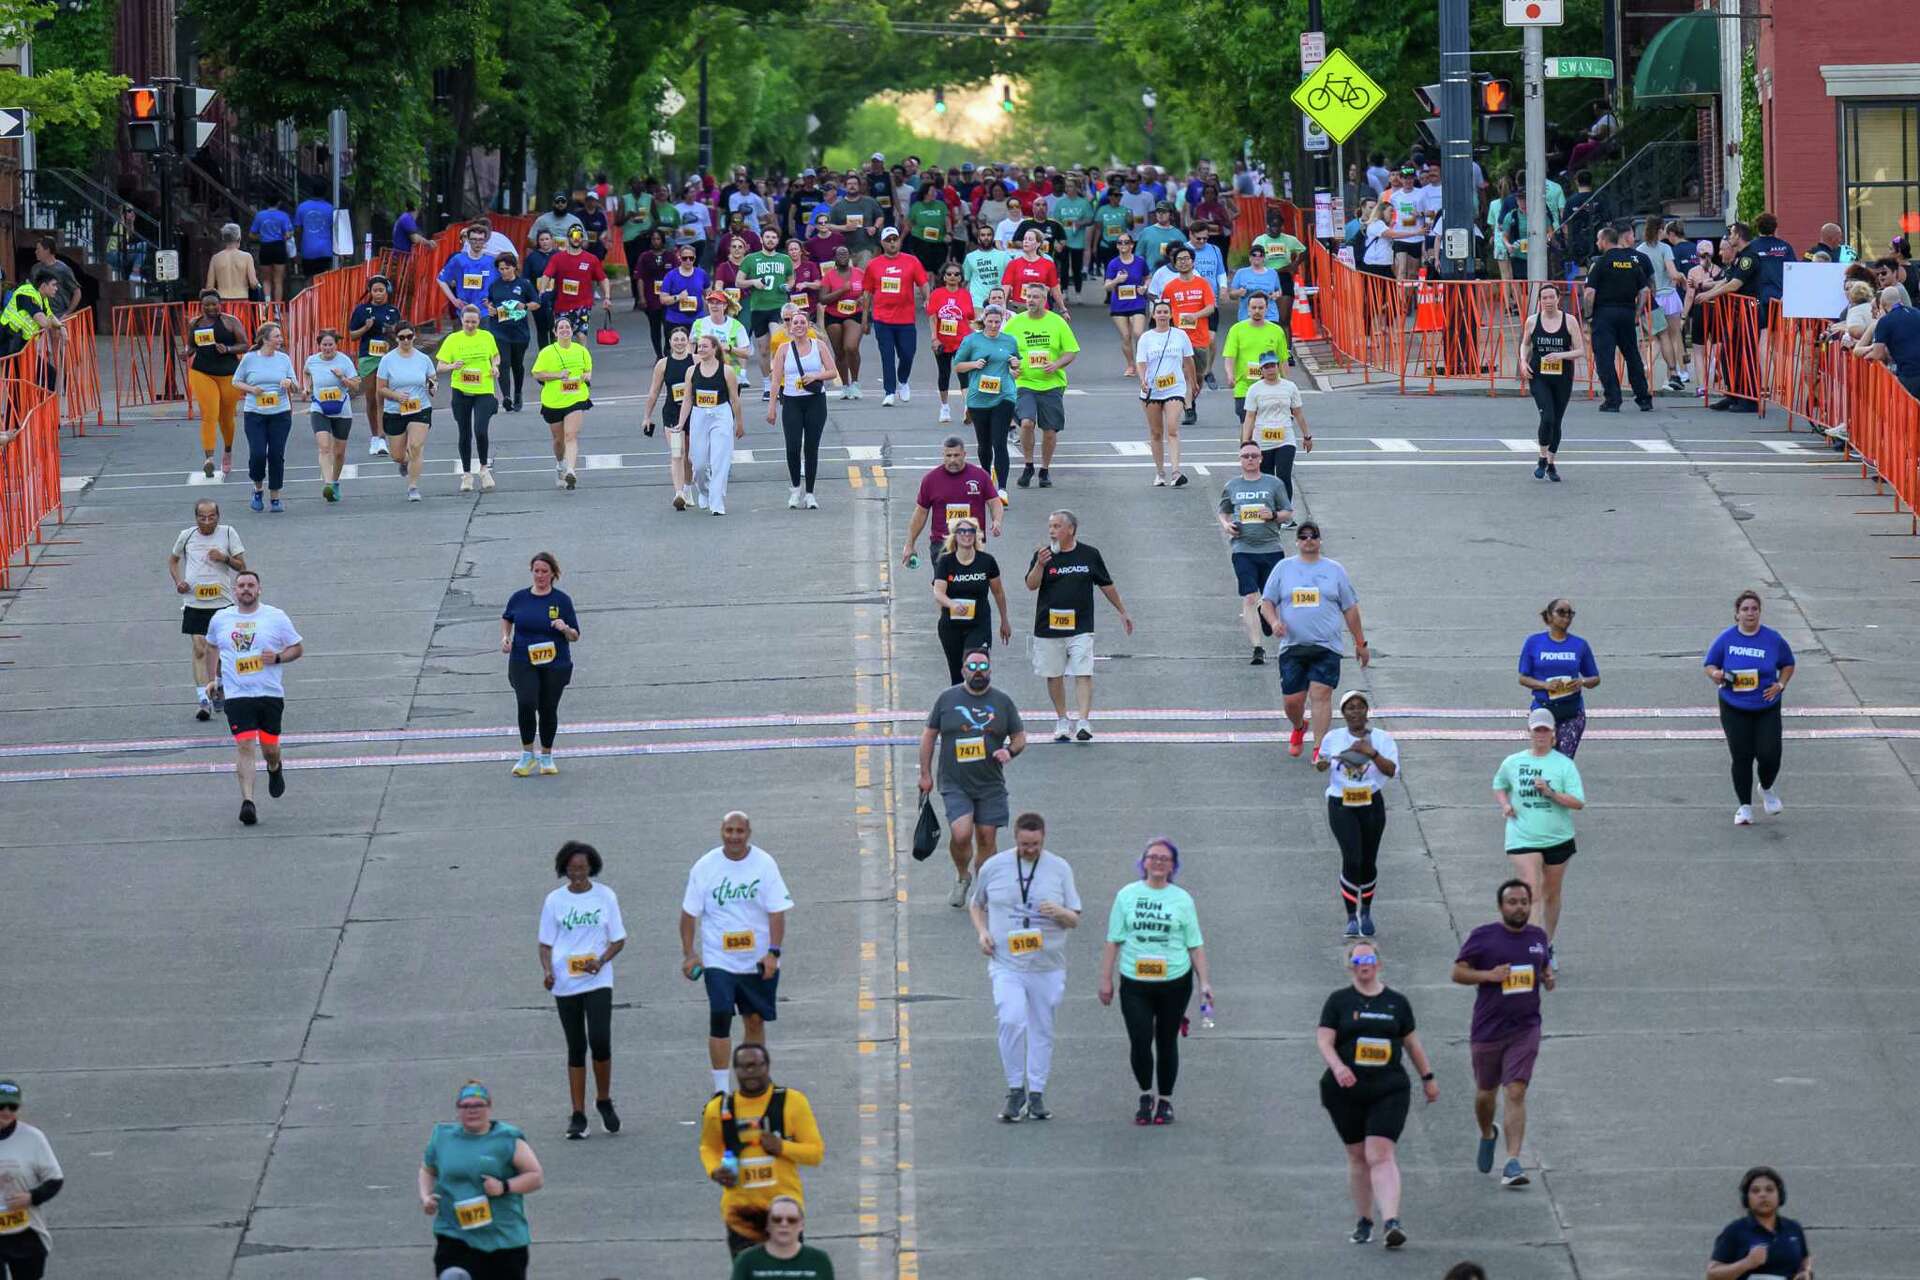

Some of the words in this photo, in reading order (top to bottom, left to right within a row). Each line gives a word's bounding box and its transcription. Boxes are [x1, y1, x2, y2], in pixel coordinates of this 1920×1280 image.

[1561, 61, 1592, 73] SWAN
[756, 262, 785, 275] BOSTON
[1613, 261, 1632, 269] POLICE
[1235, 491, 1269, 499] GDIT
[1056, 564, 1089, 576] ARCADIS
[953, 573, 987, 584] ARCADIS
[1541, 651, 1577, 662] PIONEER
[1729, 644, 1766, 659] PIONEER
[959, 745, 982, 757] 7471
[1519, 769, 1542, 777] RUN
[1136, 901, 1163, 912] RUN
[1135, 912, 1172, 922] WALK
[1133, 923, 1172, 934] UNITE
